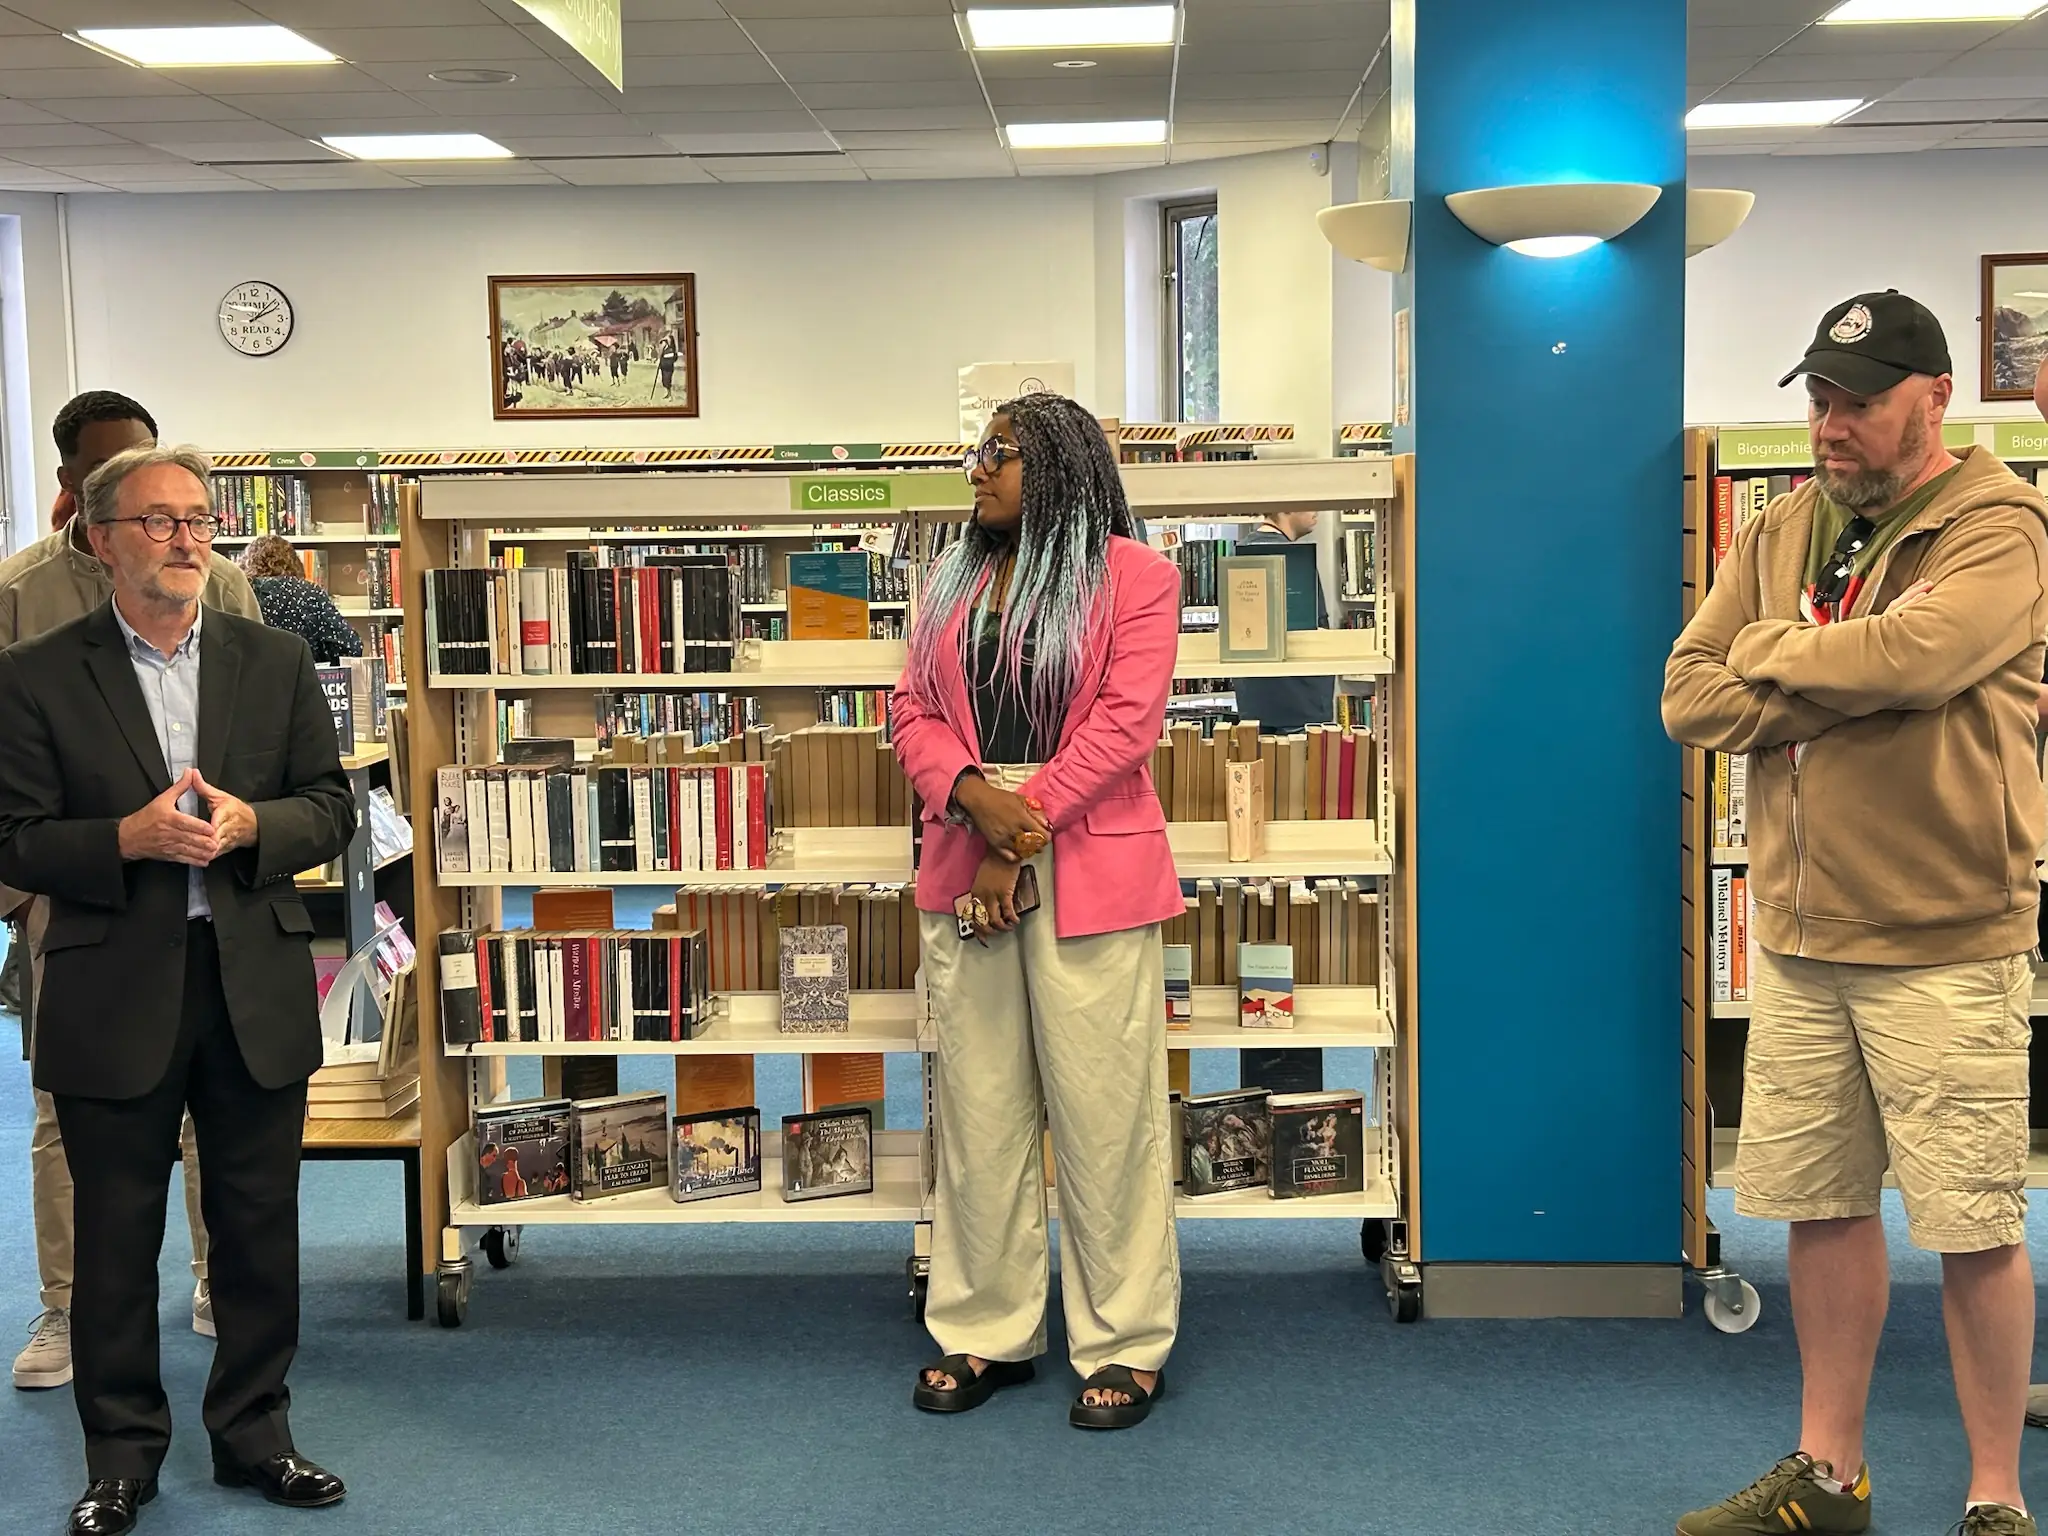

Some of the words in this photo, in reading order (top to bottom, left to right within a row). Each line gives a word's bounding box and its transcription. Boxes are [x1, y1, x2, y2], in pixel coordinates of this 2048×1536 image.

[565, 0, 619, 70] ography
[239, 292, 246, 301] 11
[250, 288, 259, 297] 12
[266, 292, 270, 301] 1
[277, 314, 284, 323] 3
[230, 327, 238, 336] 8
[242, 326, 270, 334] READ
[274, 327, 281, 335] 4
[240, 336, 247, 345] 7
[252, 339, 260, 349] 6
[265, 336, 273, 346] 5
[1737, 441, 1812, 458] Biographie
[808, 485, 885, 503] Classics
[1718, 483, 1729, 515] Diane
[1754, 485, 1765, 511] LILY
[1718, 517, 1729, 552] Abbott
[1731, 772, 1745, 794] COLE
[1717, 875, 1728, 922] Michael
[1716, 924, 1728, 971] McIntyre
[604, 1166, 626, 1175] WHERE
[708, 1166, 728, 1181] Hard
[1303, 1164, 1337, 1174] FLANDERS
[603, 1172, 619, 1181] FEAR
